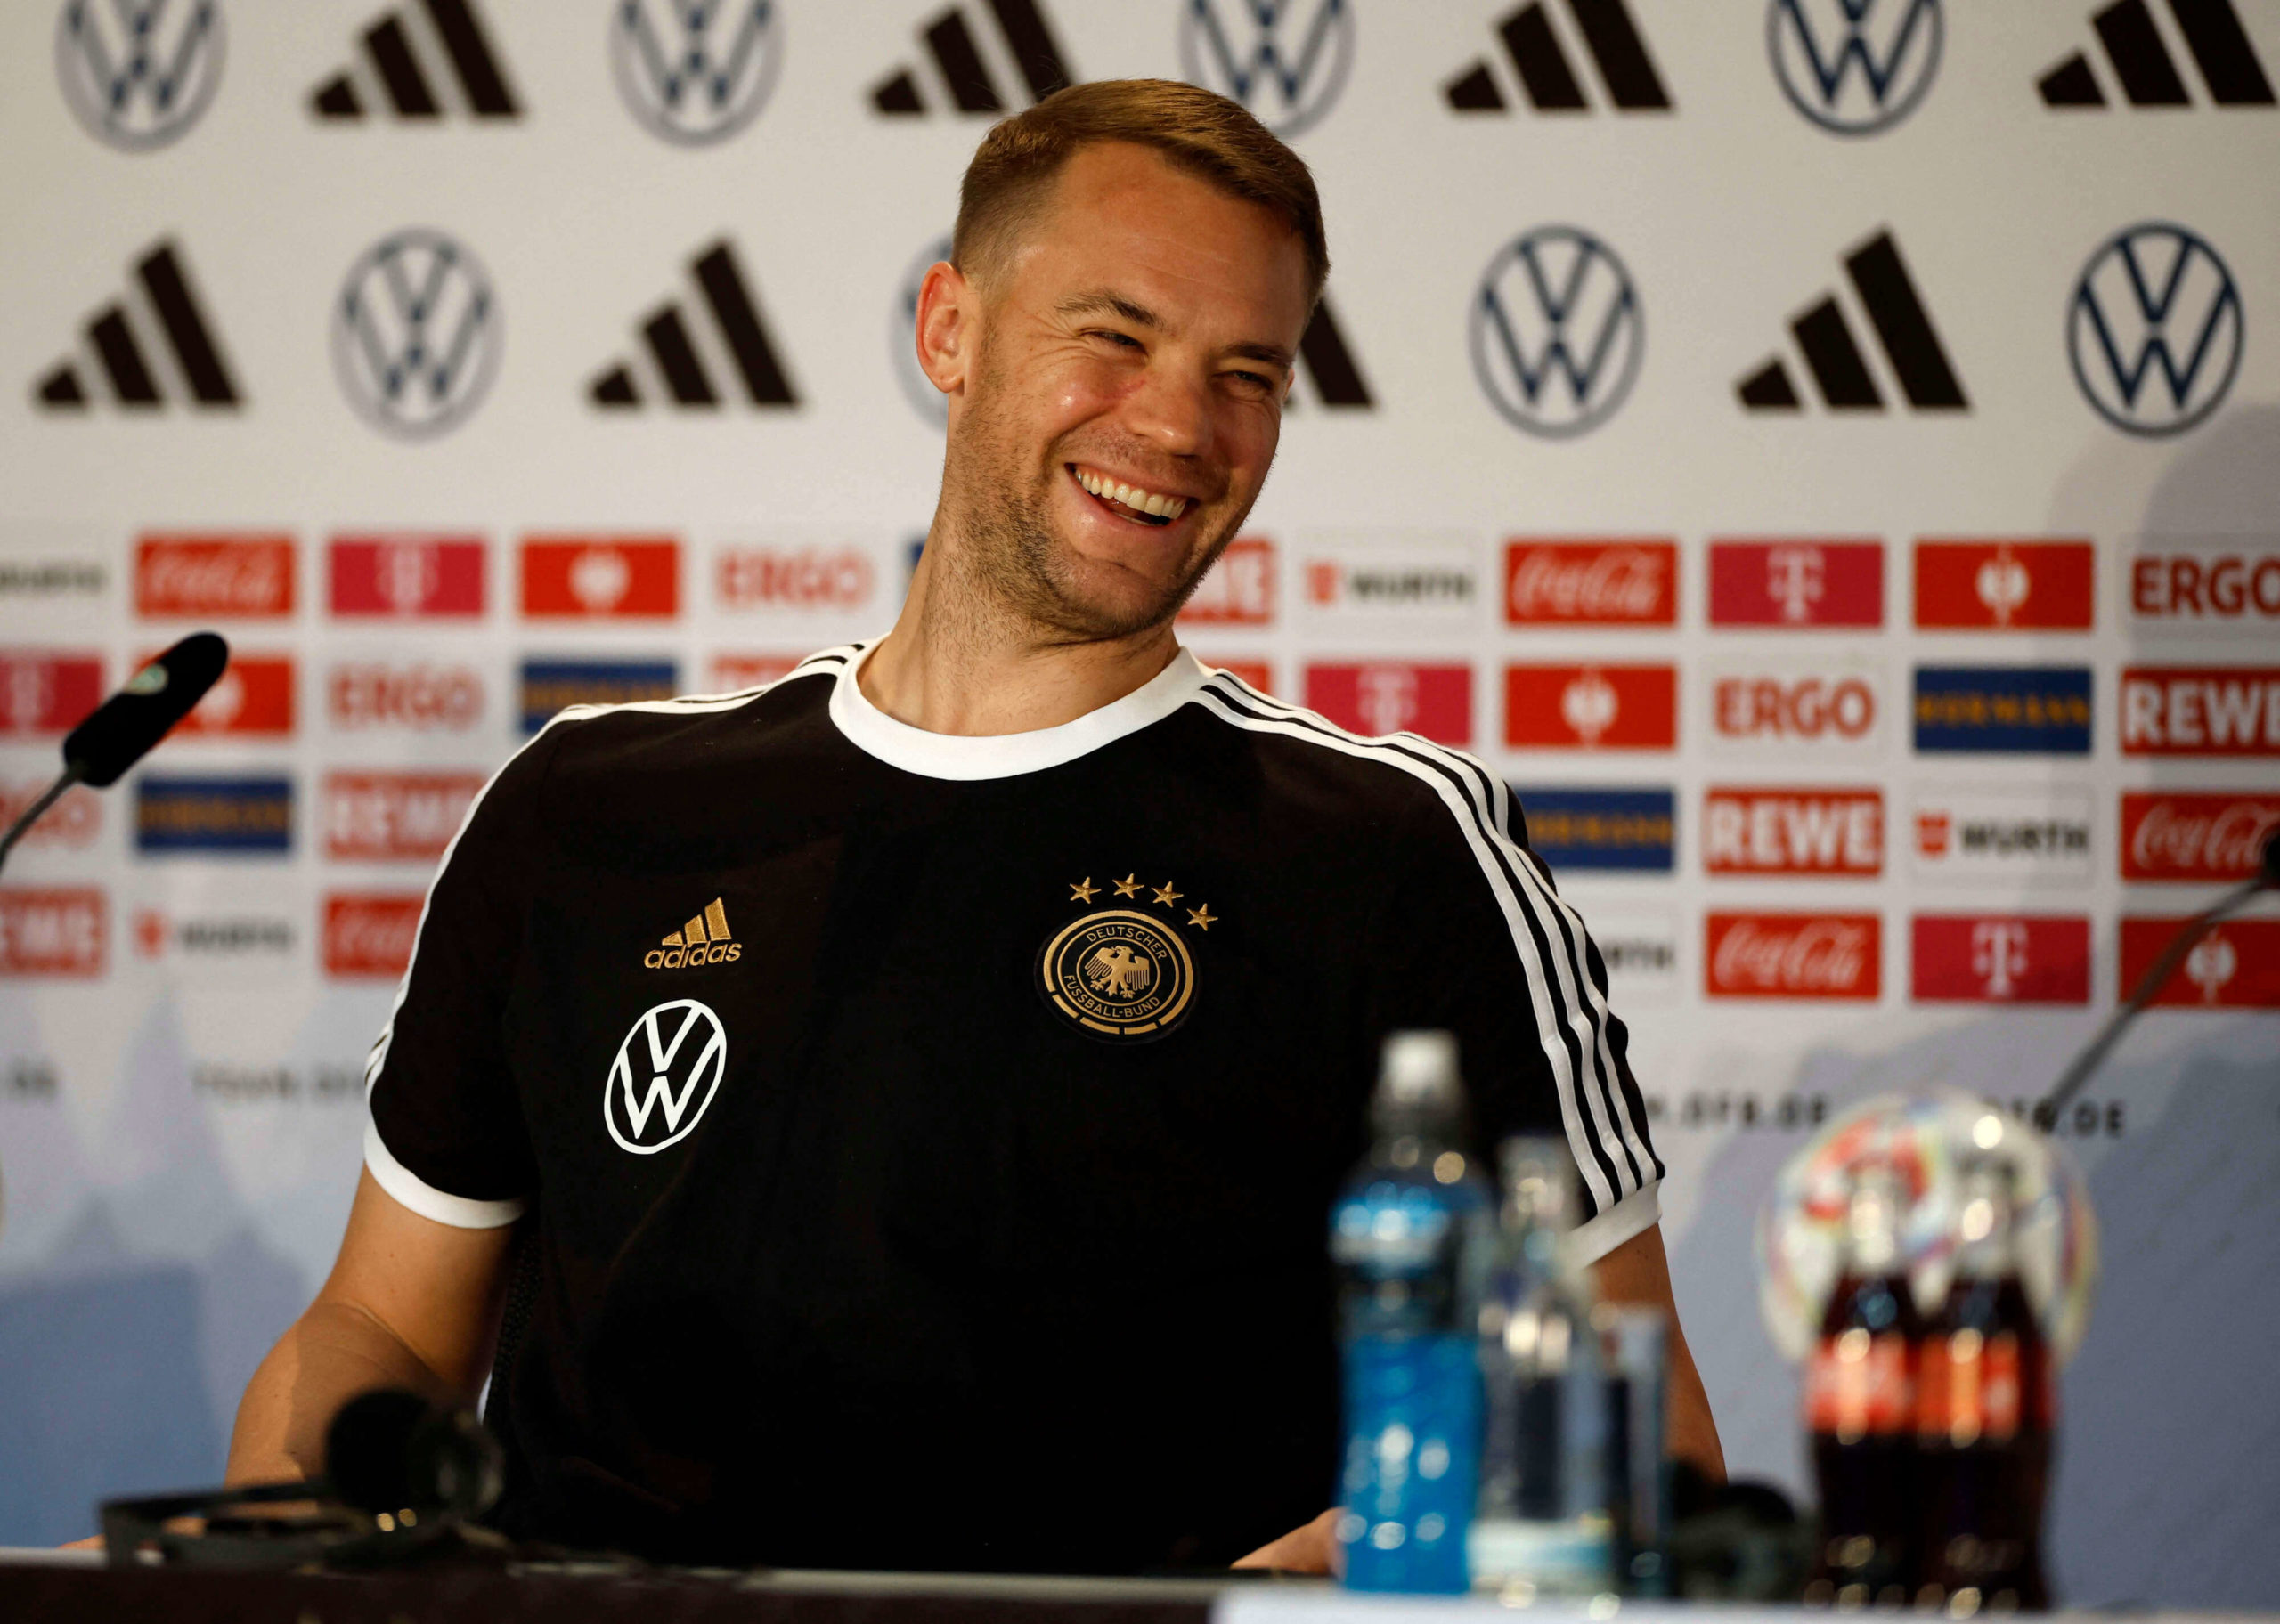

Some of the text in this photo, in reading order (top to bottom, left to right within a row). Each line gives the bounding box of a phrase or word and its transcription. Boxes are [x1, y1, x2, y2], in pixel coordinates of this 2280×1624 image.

[2132, 556, 2280, 616] ERGO
[1712, 677, 1875, 739] ERGO
[1706, 800, 1881, 865] REWE
[644, 943, 742, 969] adidas
[1086, 926, 1168, 959] DEUTSCHER
[1063, 975, 1160, 1018] FUSSBALL-BUND
[607, 1002, 725, 1151] VW
